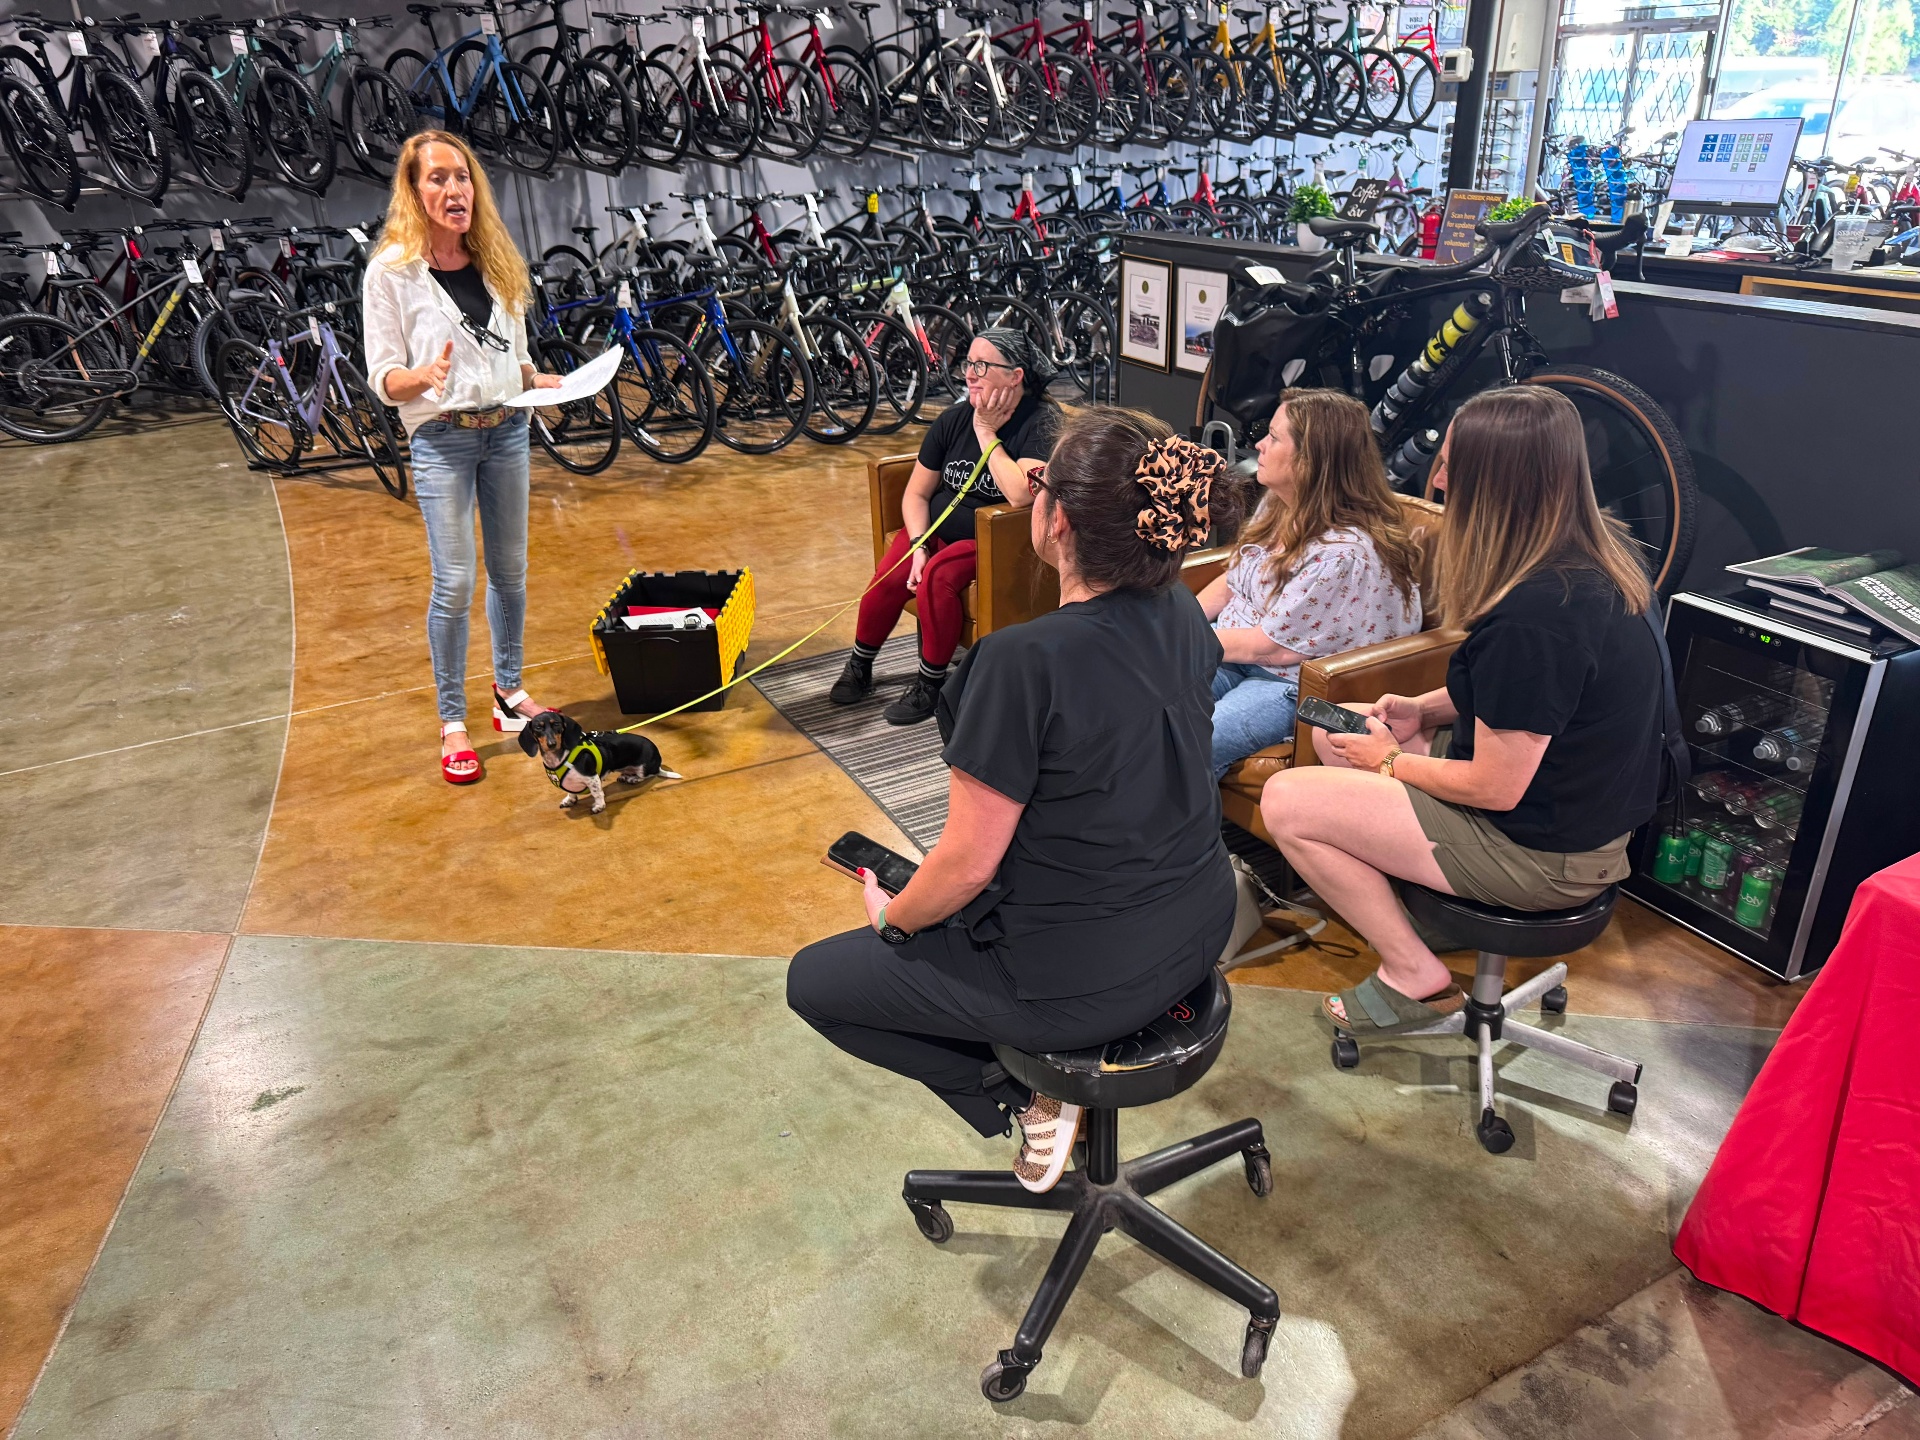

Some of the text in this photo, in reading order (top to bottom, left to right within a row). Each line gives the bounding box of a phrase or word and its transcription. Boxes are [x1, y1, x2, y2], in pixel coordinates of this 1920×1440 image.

[1352, 183, 1379, 203] Coffee
[1347, 204, 1367, 218] Bar
[1451, 211, 1463, 220] Scan
[140, 289, 182, 358] TREK
[1884, 600, 1899, 611] ON
